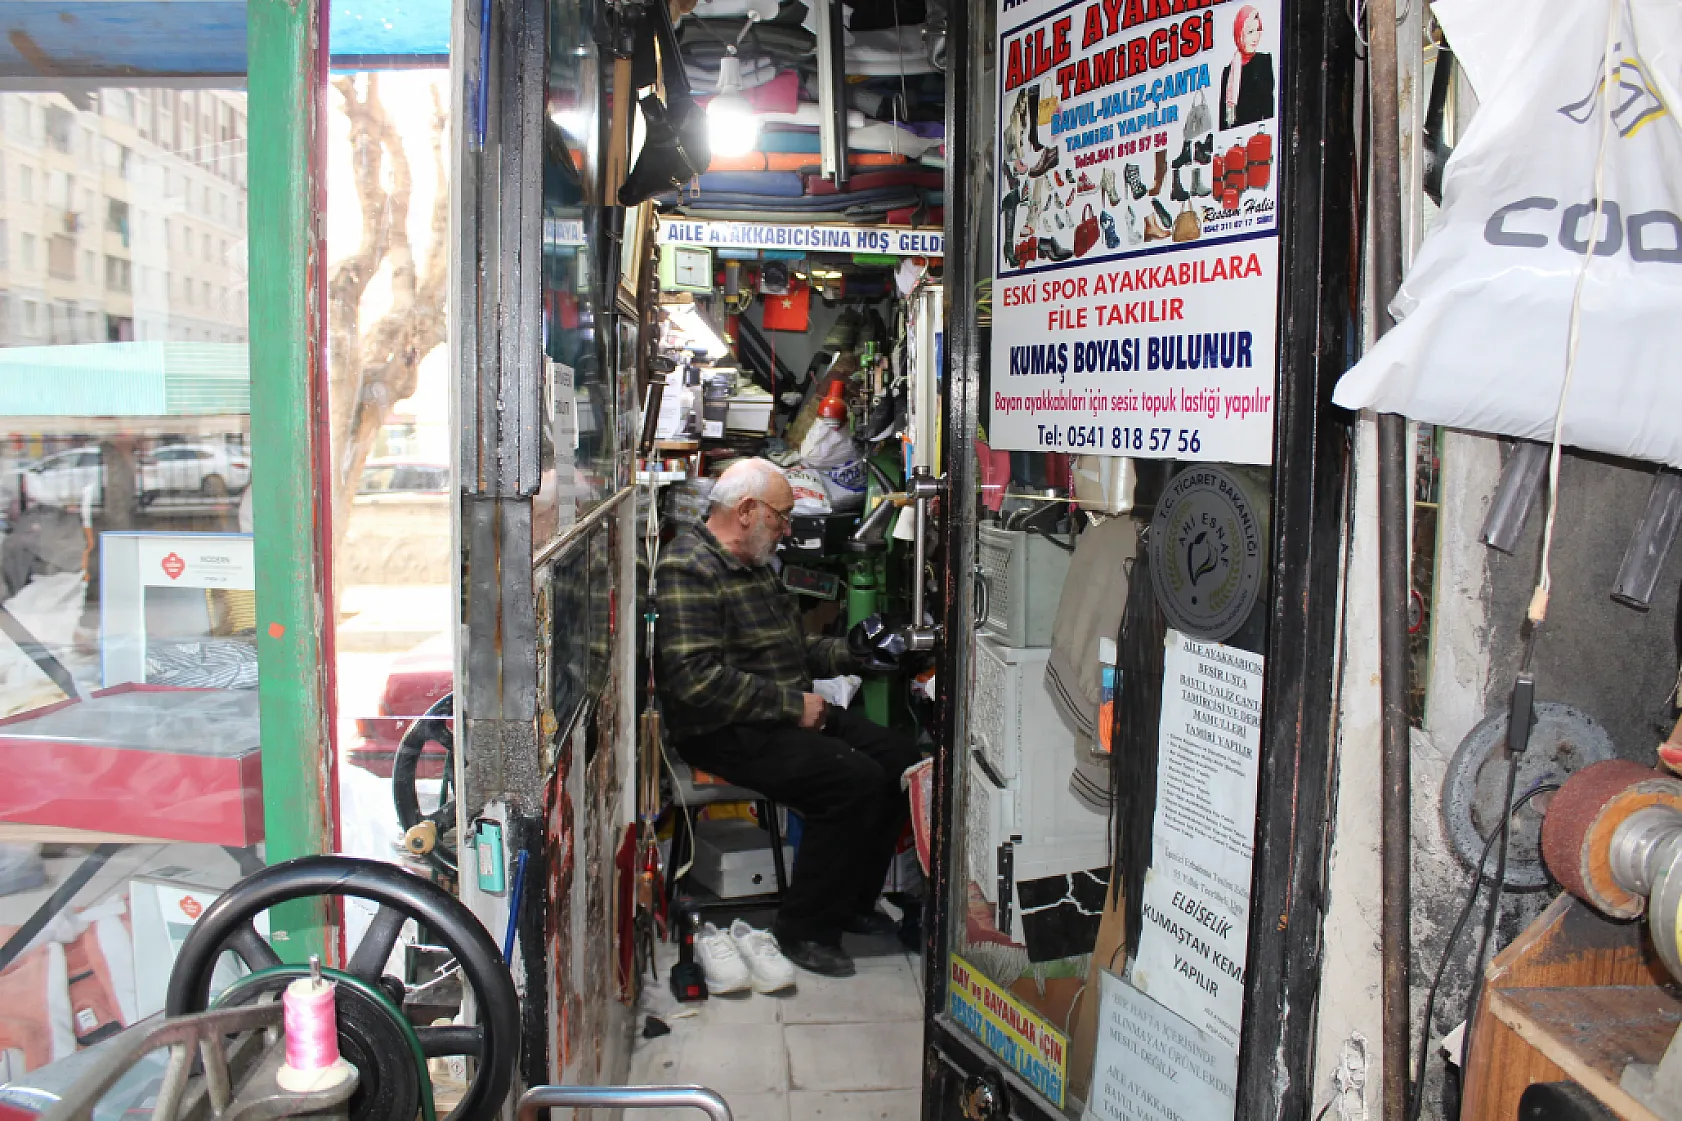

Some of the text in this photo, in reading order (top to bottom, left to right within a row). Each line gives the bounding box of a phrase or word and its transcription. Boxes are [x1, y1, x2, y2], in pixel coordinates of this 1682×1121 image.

[1117, 105, 1178, 137] YAPILIR
[857, 231, 889, 253] HOŞ
[1003, 253, 1263, 307] ESKİ SPOR AYAKKABILARA
[1048, 298, 1184, 331] FİLE TAKILIR
[1009, 330, 1253, 383] KUMAŞ BOYASI BULUNUR
[994, 391, 1022, 416] Bayan
[1089, 387, 1107, 418] için
[1142, 388, 1176, 417] topuk
[1181, 387, 1221, 419] lastiği
[1224, 387, 1271, 419] yapılır
[1037, 424, 1200, 453] Tel: 0541 818 57 56
[1174, 953, 1219, 998] YAPILIR
